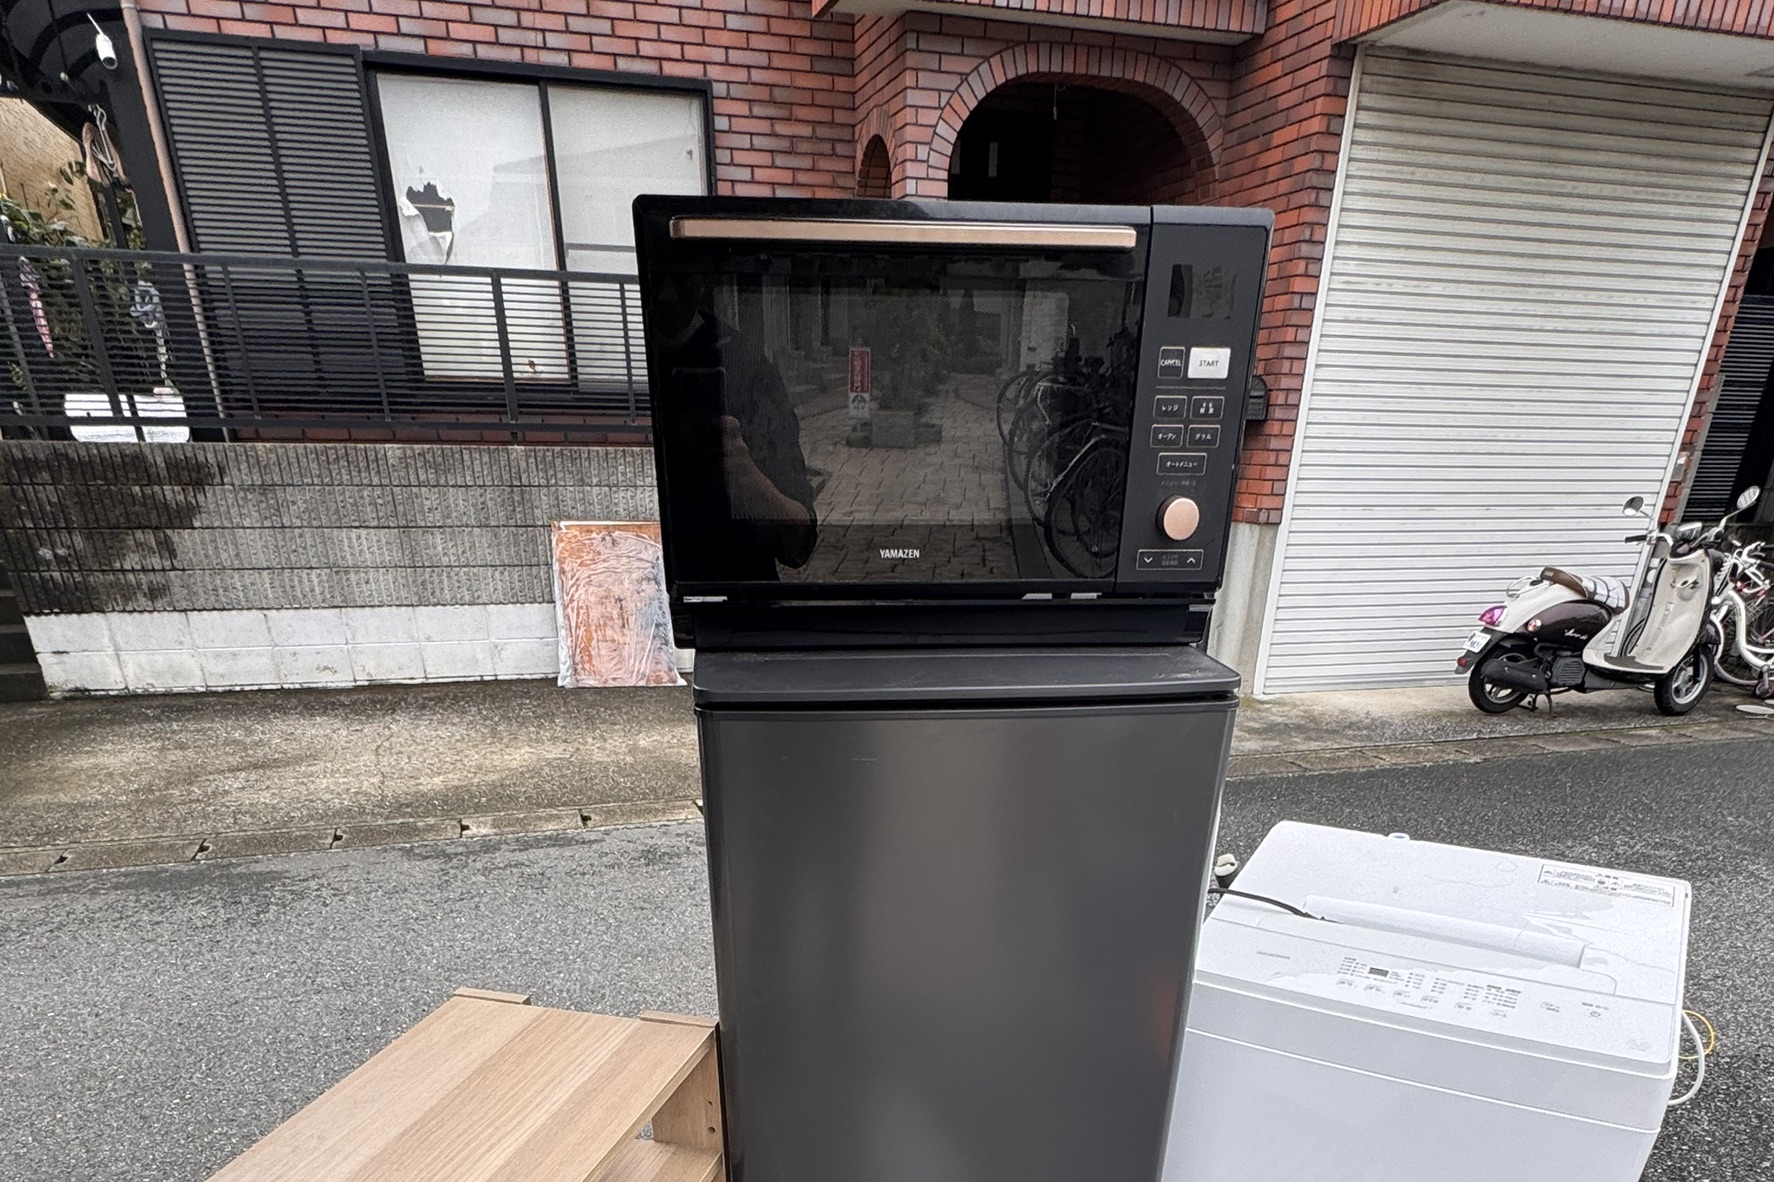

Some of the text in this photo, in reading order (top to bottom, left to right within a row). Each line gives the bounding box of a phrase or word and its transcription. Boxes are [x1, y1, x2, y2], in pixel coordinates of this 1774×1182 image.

[1160, 358, 1183, 367] CANCEL
[1199, 359, 1220, 368] START
[880, 548, 920, 559] YAMAZEN
